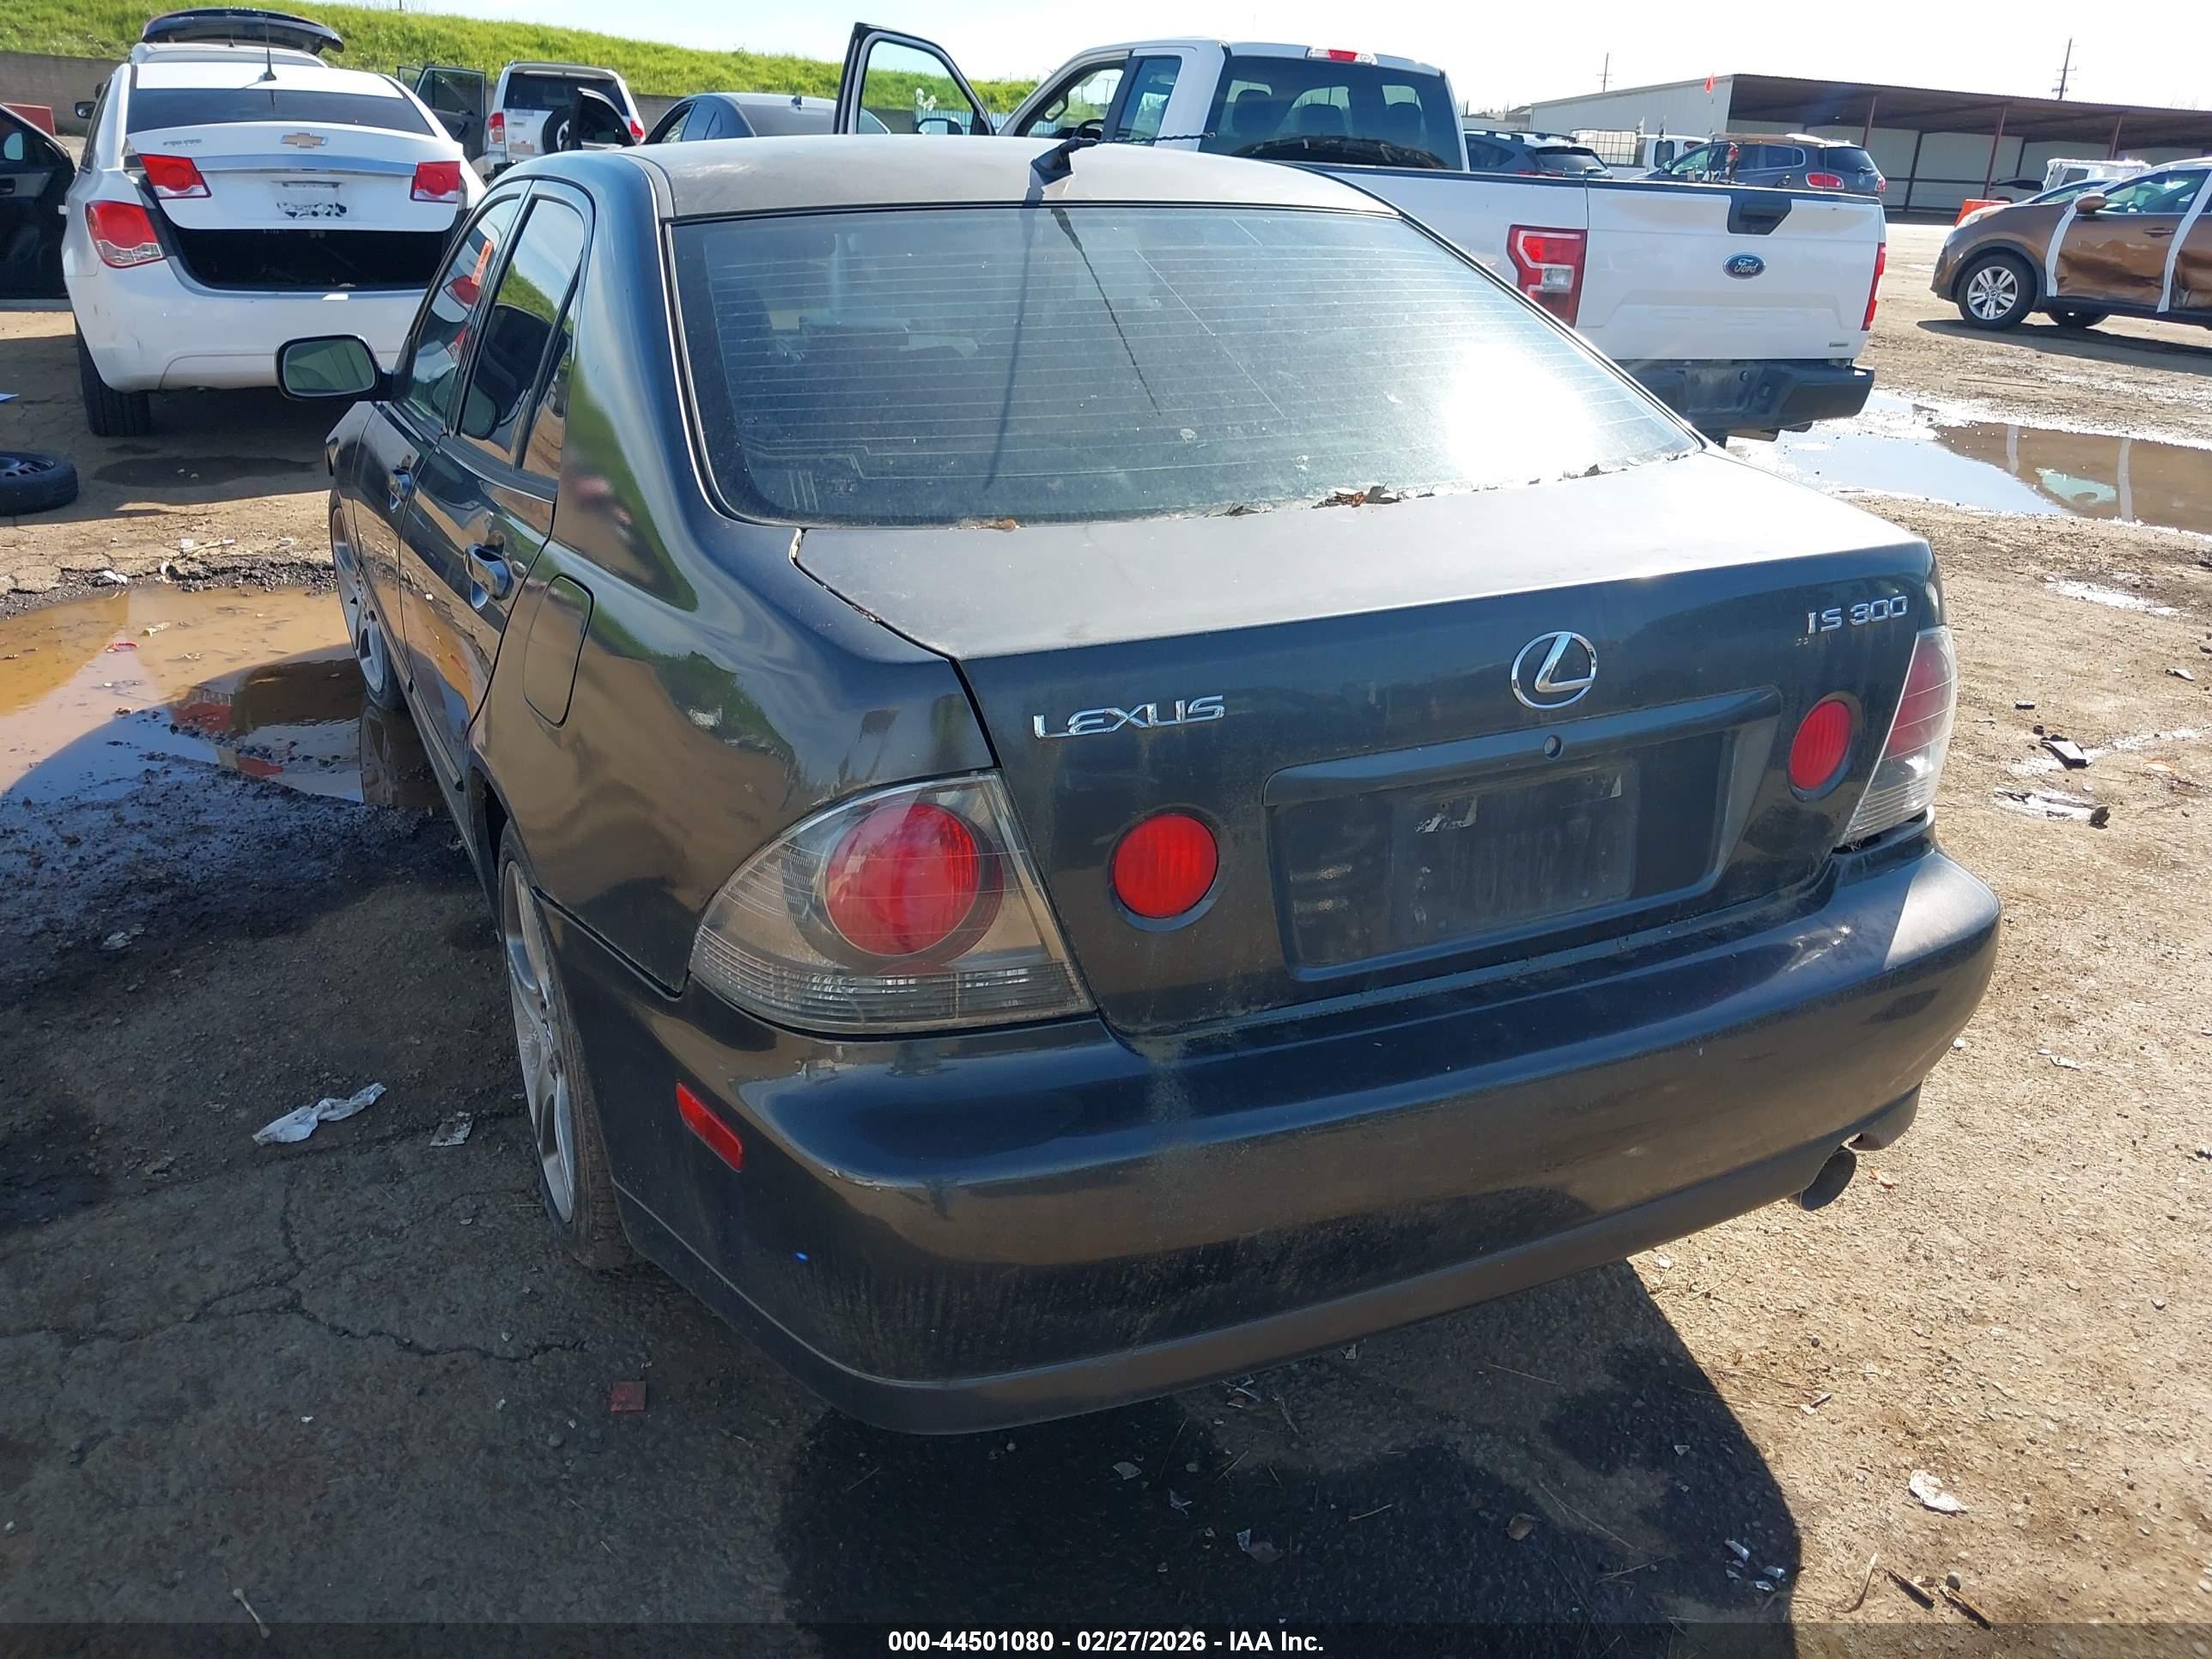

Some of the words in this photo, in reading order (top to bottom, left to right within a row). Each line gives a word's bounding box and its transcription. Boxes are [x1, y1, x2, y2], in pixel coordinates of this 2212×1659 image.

[1808, 608, 1842, 635] IS
[1849, 596, 1909, 626] 300
[1033, 695, 1226, 739] LEXUS
